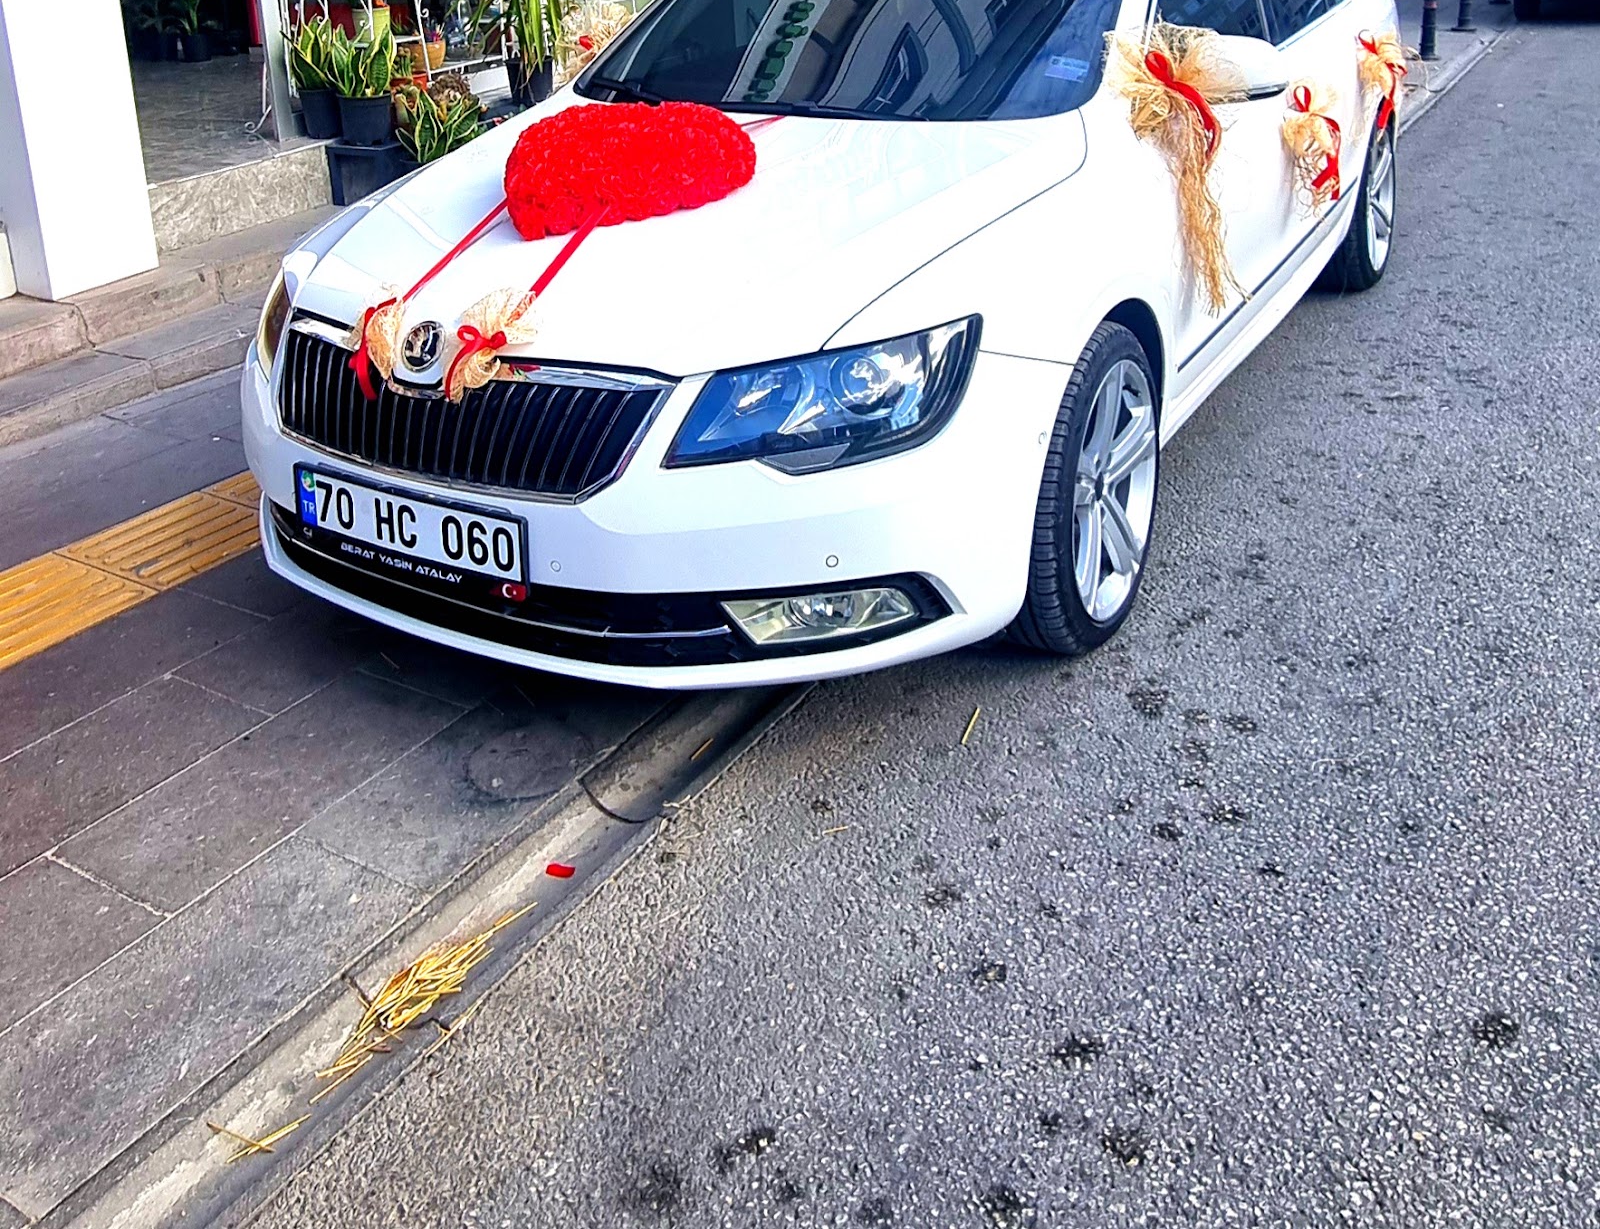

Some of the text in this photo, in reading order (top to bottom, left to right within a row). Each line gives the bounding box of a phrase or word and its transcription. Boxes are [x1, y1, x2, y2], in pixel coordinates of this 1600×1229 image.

[302, 499, 316, 515] TR
[315, 479, 515, 573] 70 HC 060
[340, 542, 376, 560] BERAT
[415, 565, 463, 584] ATALAY
